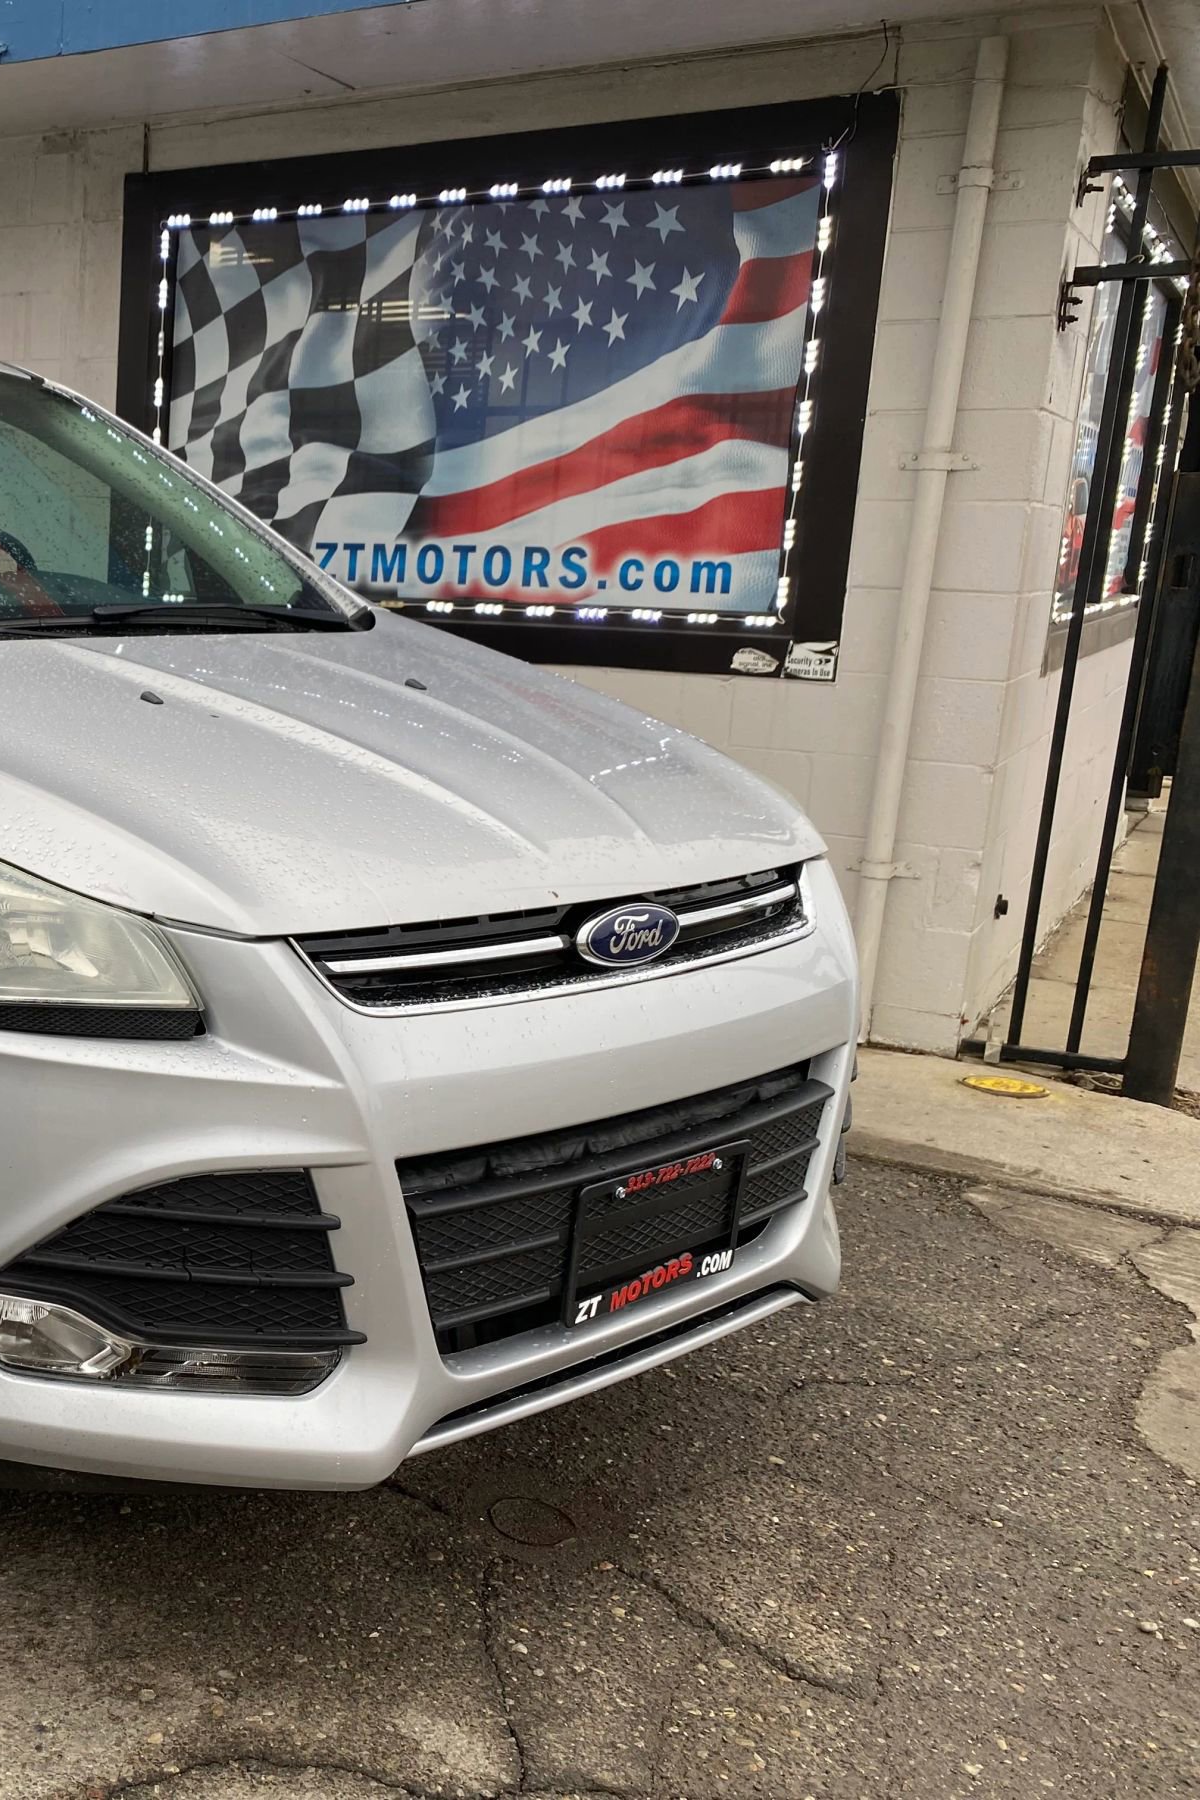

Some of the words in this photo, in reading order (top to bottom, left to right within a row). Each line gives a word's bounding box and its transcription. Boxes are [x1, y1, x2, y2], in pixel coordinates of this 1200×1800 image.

[315, 542, 733, 594] ZTMOTORS.com
[609, 913, 663, 954] Ford
[574, 1295, 602, 1325] ZT
[609, 1252, 694, 1313] MOTORS
[696, 1250, 734, 1278] .COM
